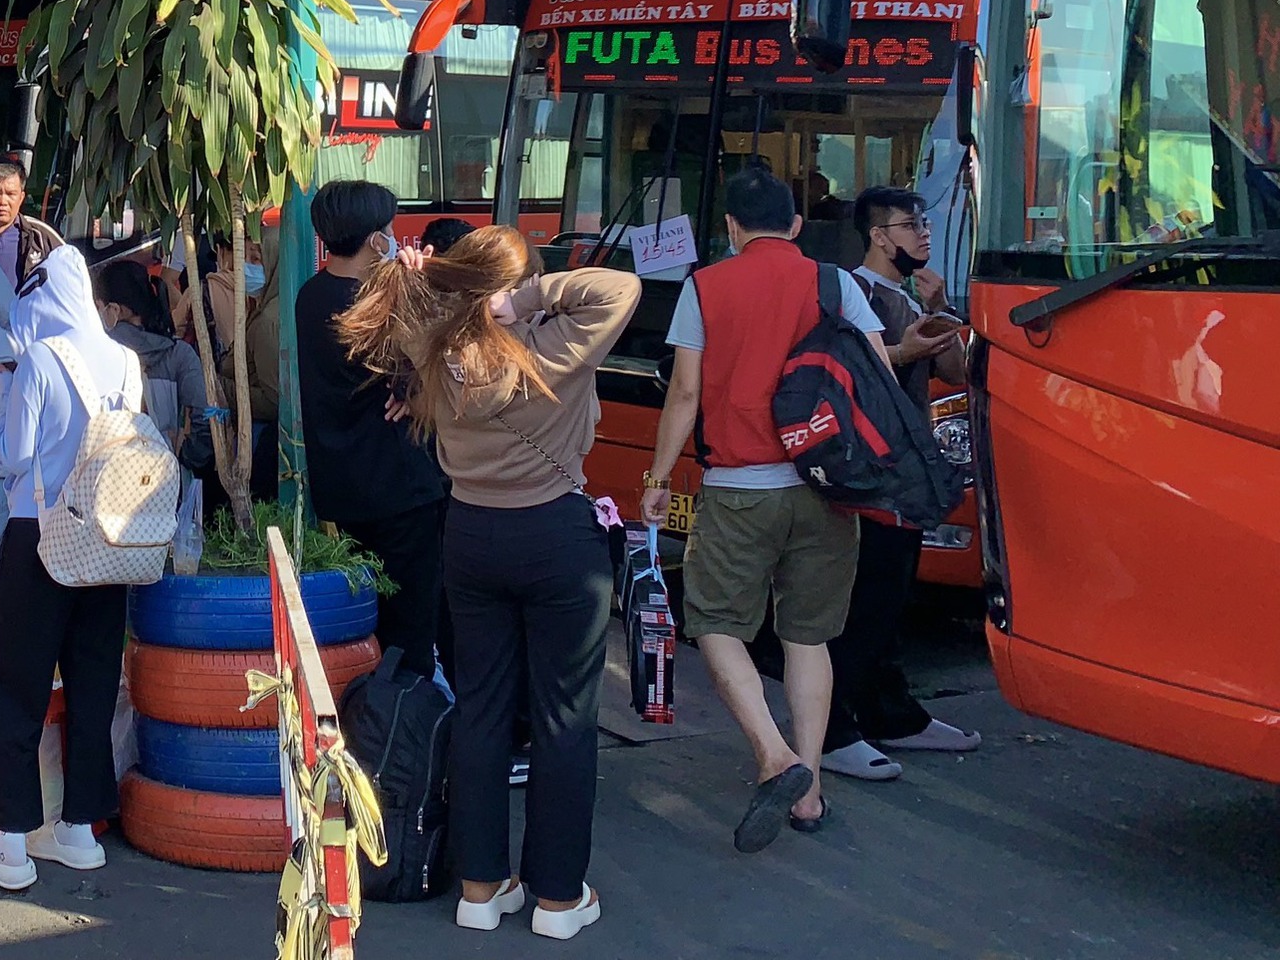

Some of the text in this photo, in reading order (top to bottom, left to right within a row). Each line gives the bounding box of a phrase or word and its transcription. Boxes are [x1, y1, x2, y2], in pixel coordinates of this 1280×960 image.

[539, 0, 714, 26] BẾN XE MIỀN TÂY
[565, 30, 681, 65] FUTA
[694, 30, 782, 66] Bus
